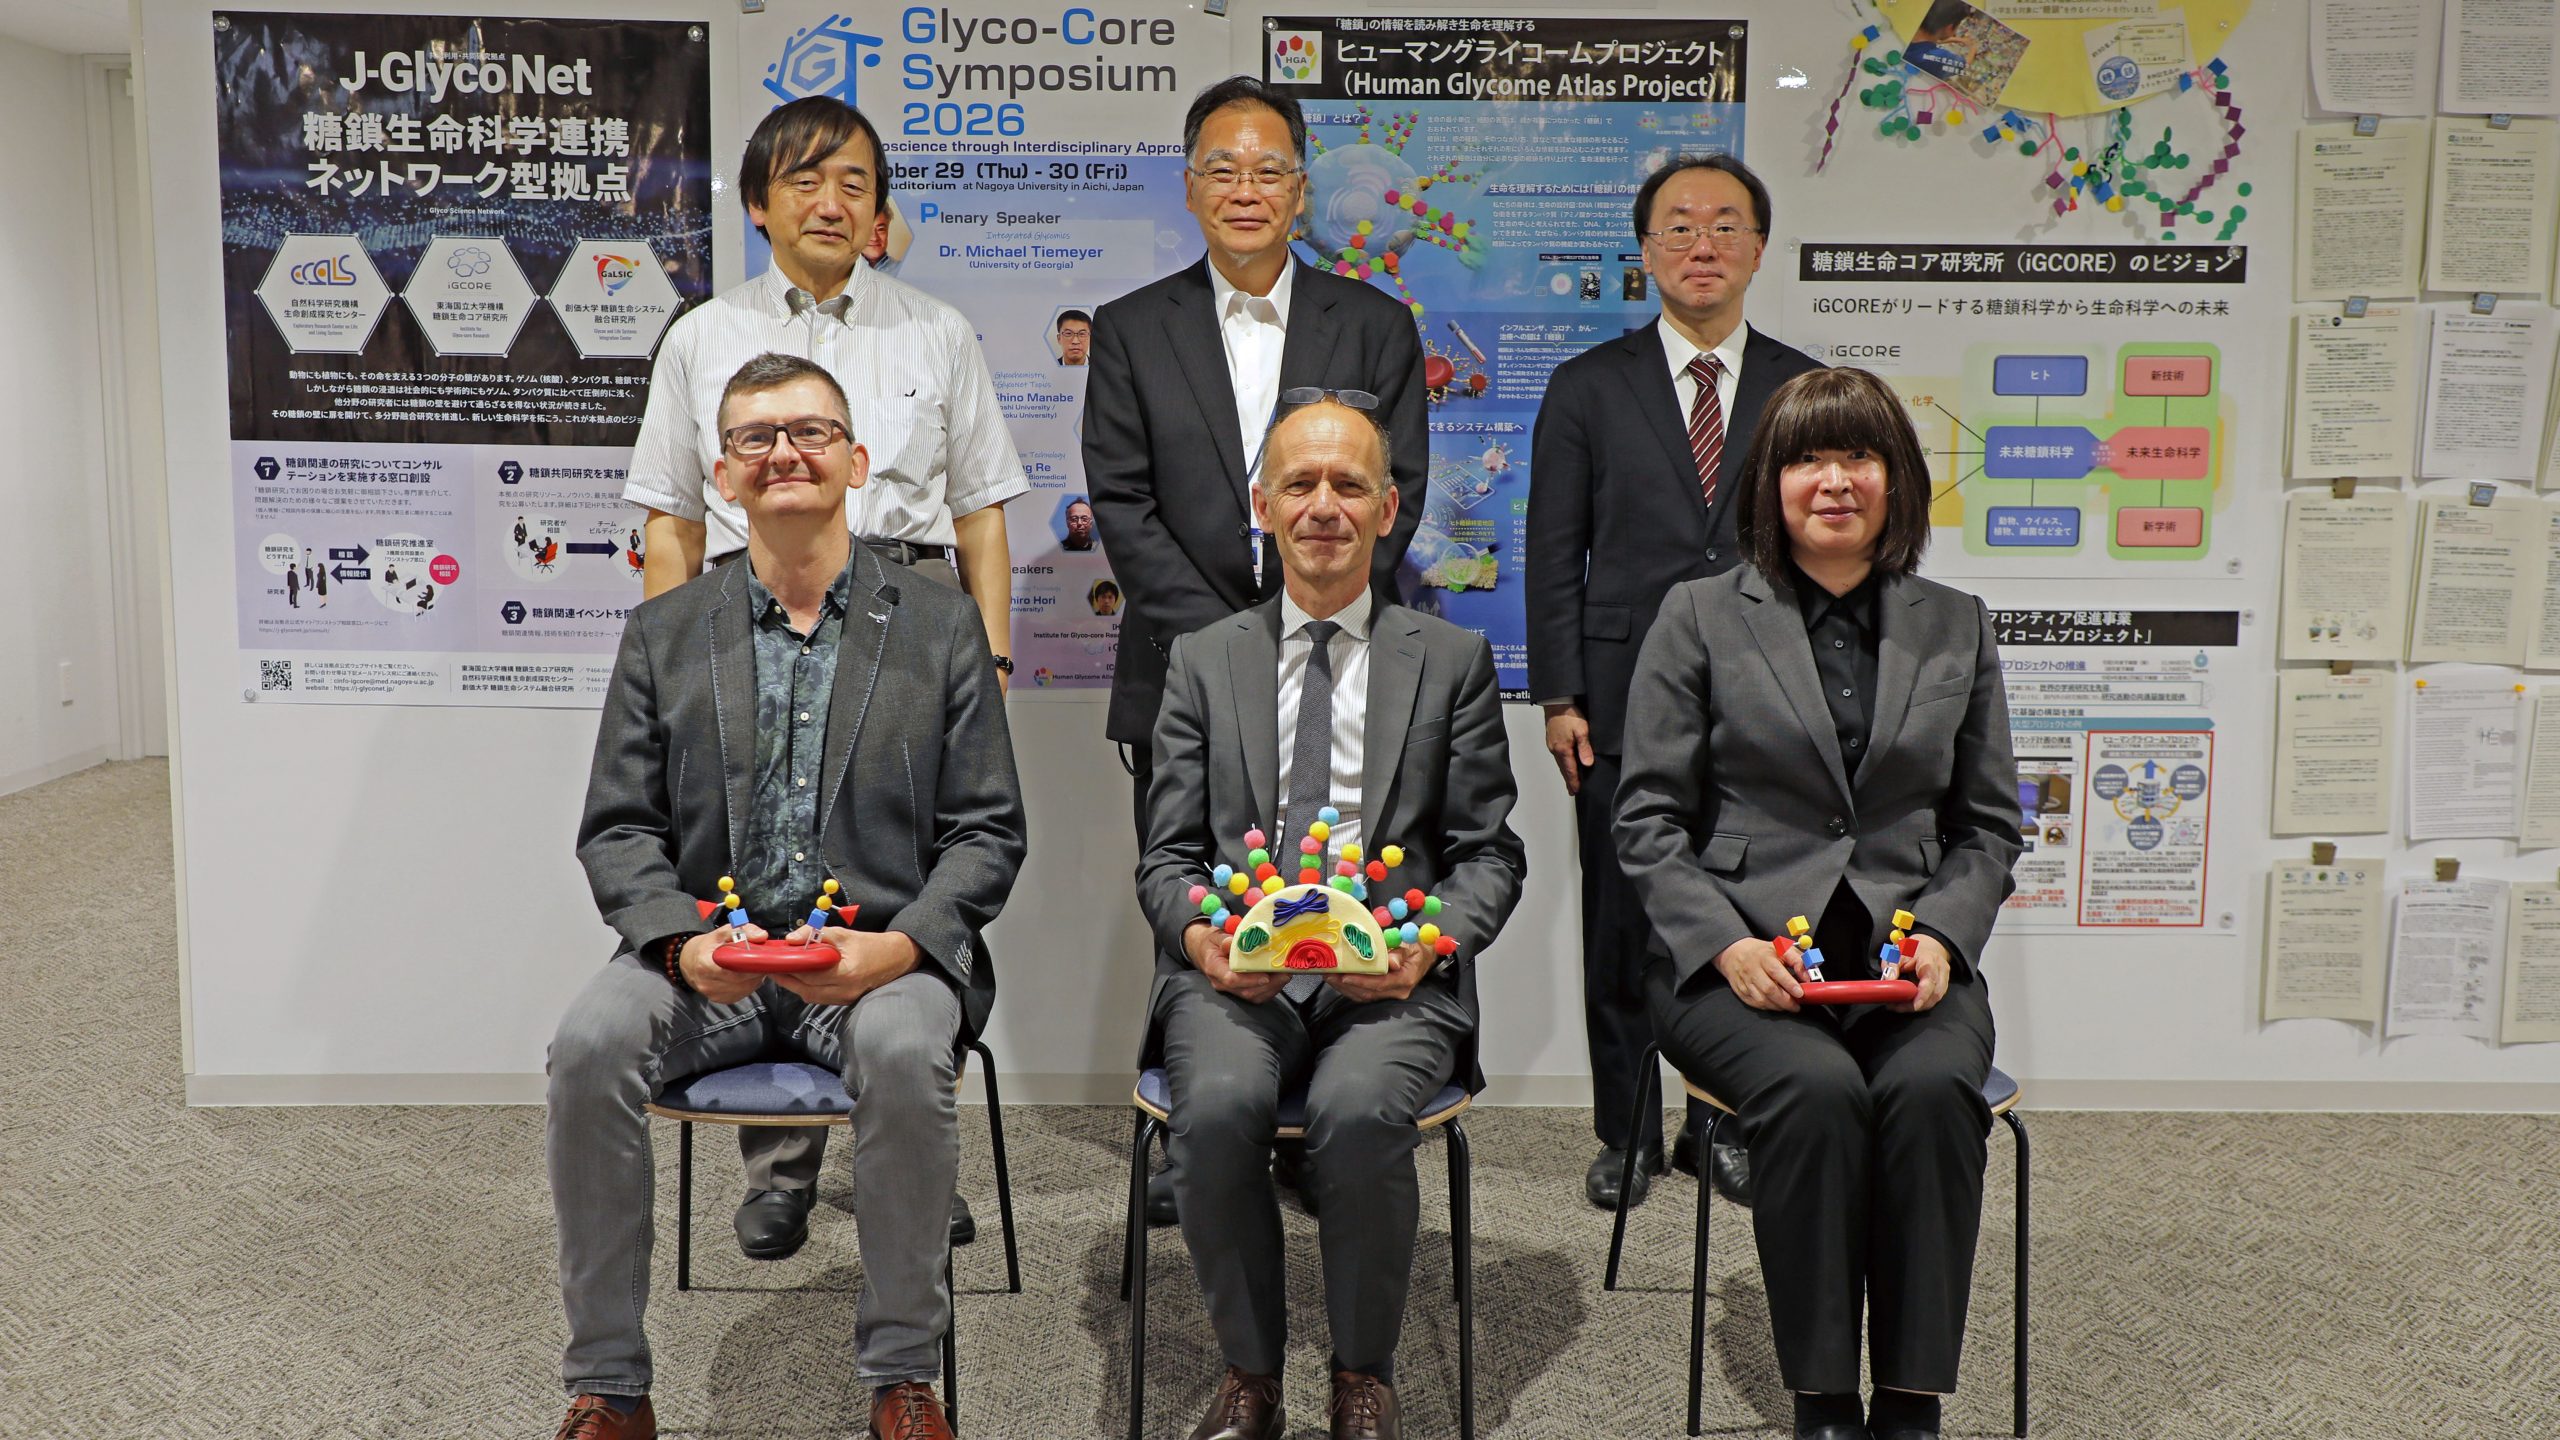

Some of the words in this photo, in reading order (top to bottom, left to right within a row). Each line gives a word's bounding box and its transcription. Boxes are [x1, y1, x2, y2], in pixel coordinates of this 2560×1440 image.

[901, 6, 1176, 53] Glyco-Core
[1335, 18, 1536, 32] 「糖鎖」の情報を読み解き生命を理解する
[1337, 38, 1724, 67] ヒューマングライコームプロジェクト
[1285, 55, 1307, 65] HGA
[902, 53, 1177, 98] Symposium
[1344, 69, 1440, 97] (Human
[1447, 71, 1550, 101] Glycome
[1556, 73, 1617, 97] Atlas
[1623, 72, 1716, 103] Project)
[902, 102, 1025, 136] 2026
[303, 112, 630, 158] 糖鎖生命科学連携
[882, 140, 947, 152] oscience
[952, 140, 1009, 155] through
[1013, 141, 1132, 156] Interdisciplinary
[887, 162, 929, 178] ober
[935, 162, 965, 179] 29
[976, 162, 1028, 180] (Thu)
[1049, 163, 1079, 180] 30
[1085, 163, 1128, 180] (Fri)
[306, 159, 631, 202] ネットワーク型拠点
[889, 181, 957, 190] uditorium
[962, 183, 974, 191] at
[975, 182, 1015, 193] Nagoya
[1017, 182, 1068, 193] University
[1070, 182, 1080, 191] in
[1082, 182, 1110, 193] Aichi,
[1112, 183, 1144, 193] Japan
[429, 207, 448, 215] Glyco
[450, 207, 475, 215] Science
[920, 202, 988, 226] Plenary
[996, 212, 1062, 227] Speaker
[985, 231, 1032, 241] Integrated
[1034, 231, 1071, 241] Glycomics
[939, 245, 961, 258] Dr.
[965, 245, 1027, 258] Michael
[1031, 246, 1103, 261] Tiemeyer
[969, 260, 1019, 270] (University
[1022, 260, 1033, 269] of
[1034, 261, 1073, 271] Georgia)
[1812, 249, 2236, 275] 糖鎖生命コア研究所（iGCORE）のビジョン
[601, 270, 633, 278] GaLSIC
[447, 281, 492, 290] iGCORE
[291, 299, 359, 309] 自然科学研究機構
[436, 301, 504, 311] 東海国立大学機構
[565, 303, 599, 313] 創価大学
[600, 304, 665, 313] 糖鎖生命システム
[1812, 297, 2230, 317] iGCOREがリードする糖鎖科学から生命科学への未来
[432, 312, 508, 322] 糖鎖生命コア研究所
[594, 315, 636, 324] 融合研究所
[1829, 345, 1901, 358] iGCORE
[2030, 369, 2050, 381] ヒト
[2151, 370, 2184, 381] 新技術
[1027, 393, 1074, 402] Manabe
[1015, 404, 1051, 412] University
[1999, 446, 2074, 459] 未来糖鎖科学
[2126, 446, 2201, 459] 未来生命科学
[285, 457, 442, 471] 糖鎖関連の研究についてコンサル
[1036, 463, 1051, 472] Re
[286, 471, 431, 484] テーションを実施する窓口創設
[540, 519, 567, 527] 研究者が
[1998, 516, 2063, 527] 動物、ウイルス、
[2143, 521, 2176, 532] 新学術
[375, 539, 434, 548] 糖鎖研究推進室
[1011, 564, 1054, 575] eakers
[1033, 596, 1056, 605] Hori
[1070, 632, 1104, 640] Glyco-core
[1993, 628, 2152, 645] イコームプロジェクト」
[461, 664, 514, 672] 東海国立大学機構
[515, 665, 574, 673] 糖鎖生命コア研究所
